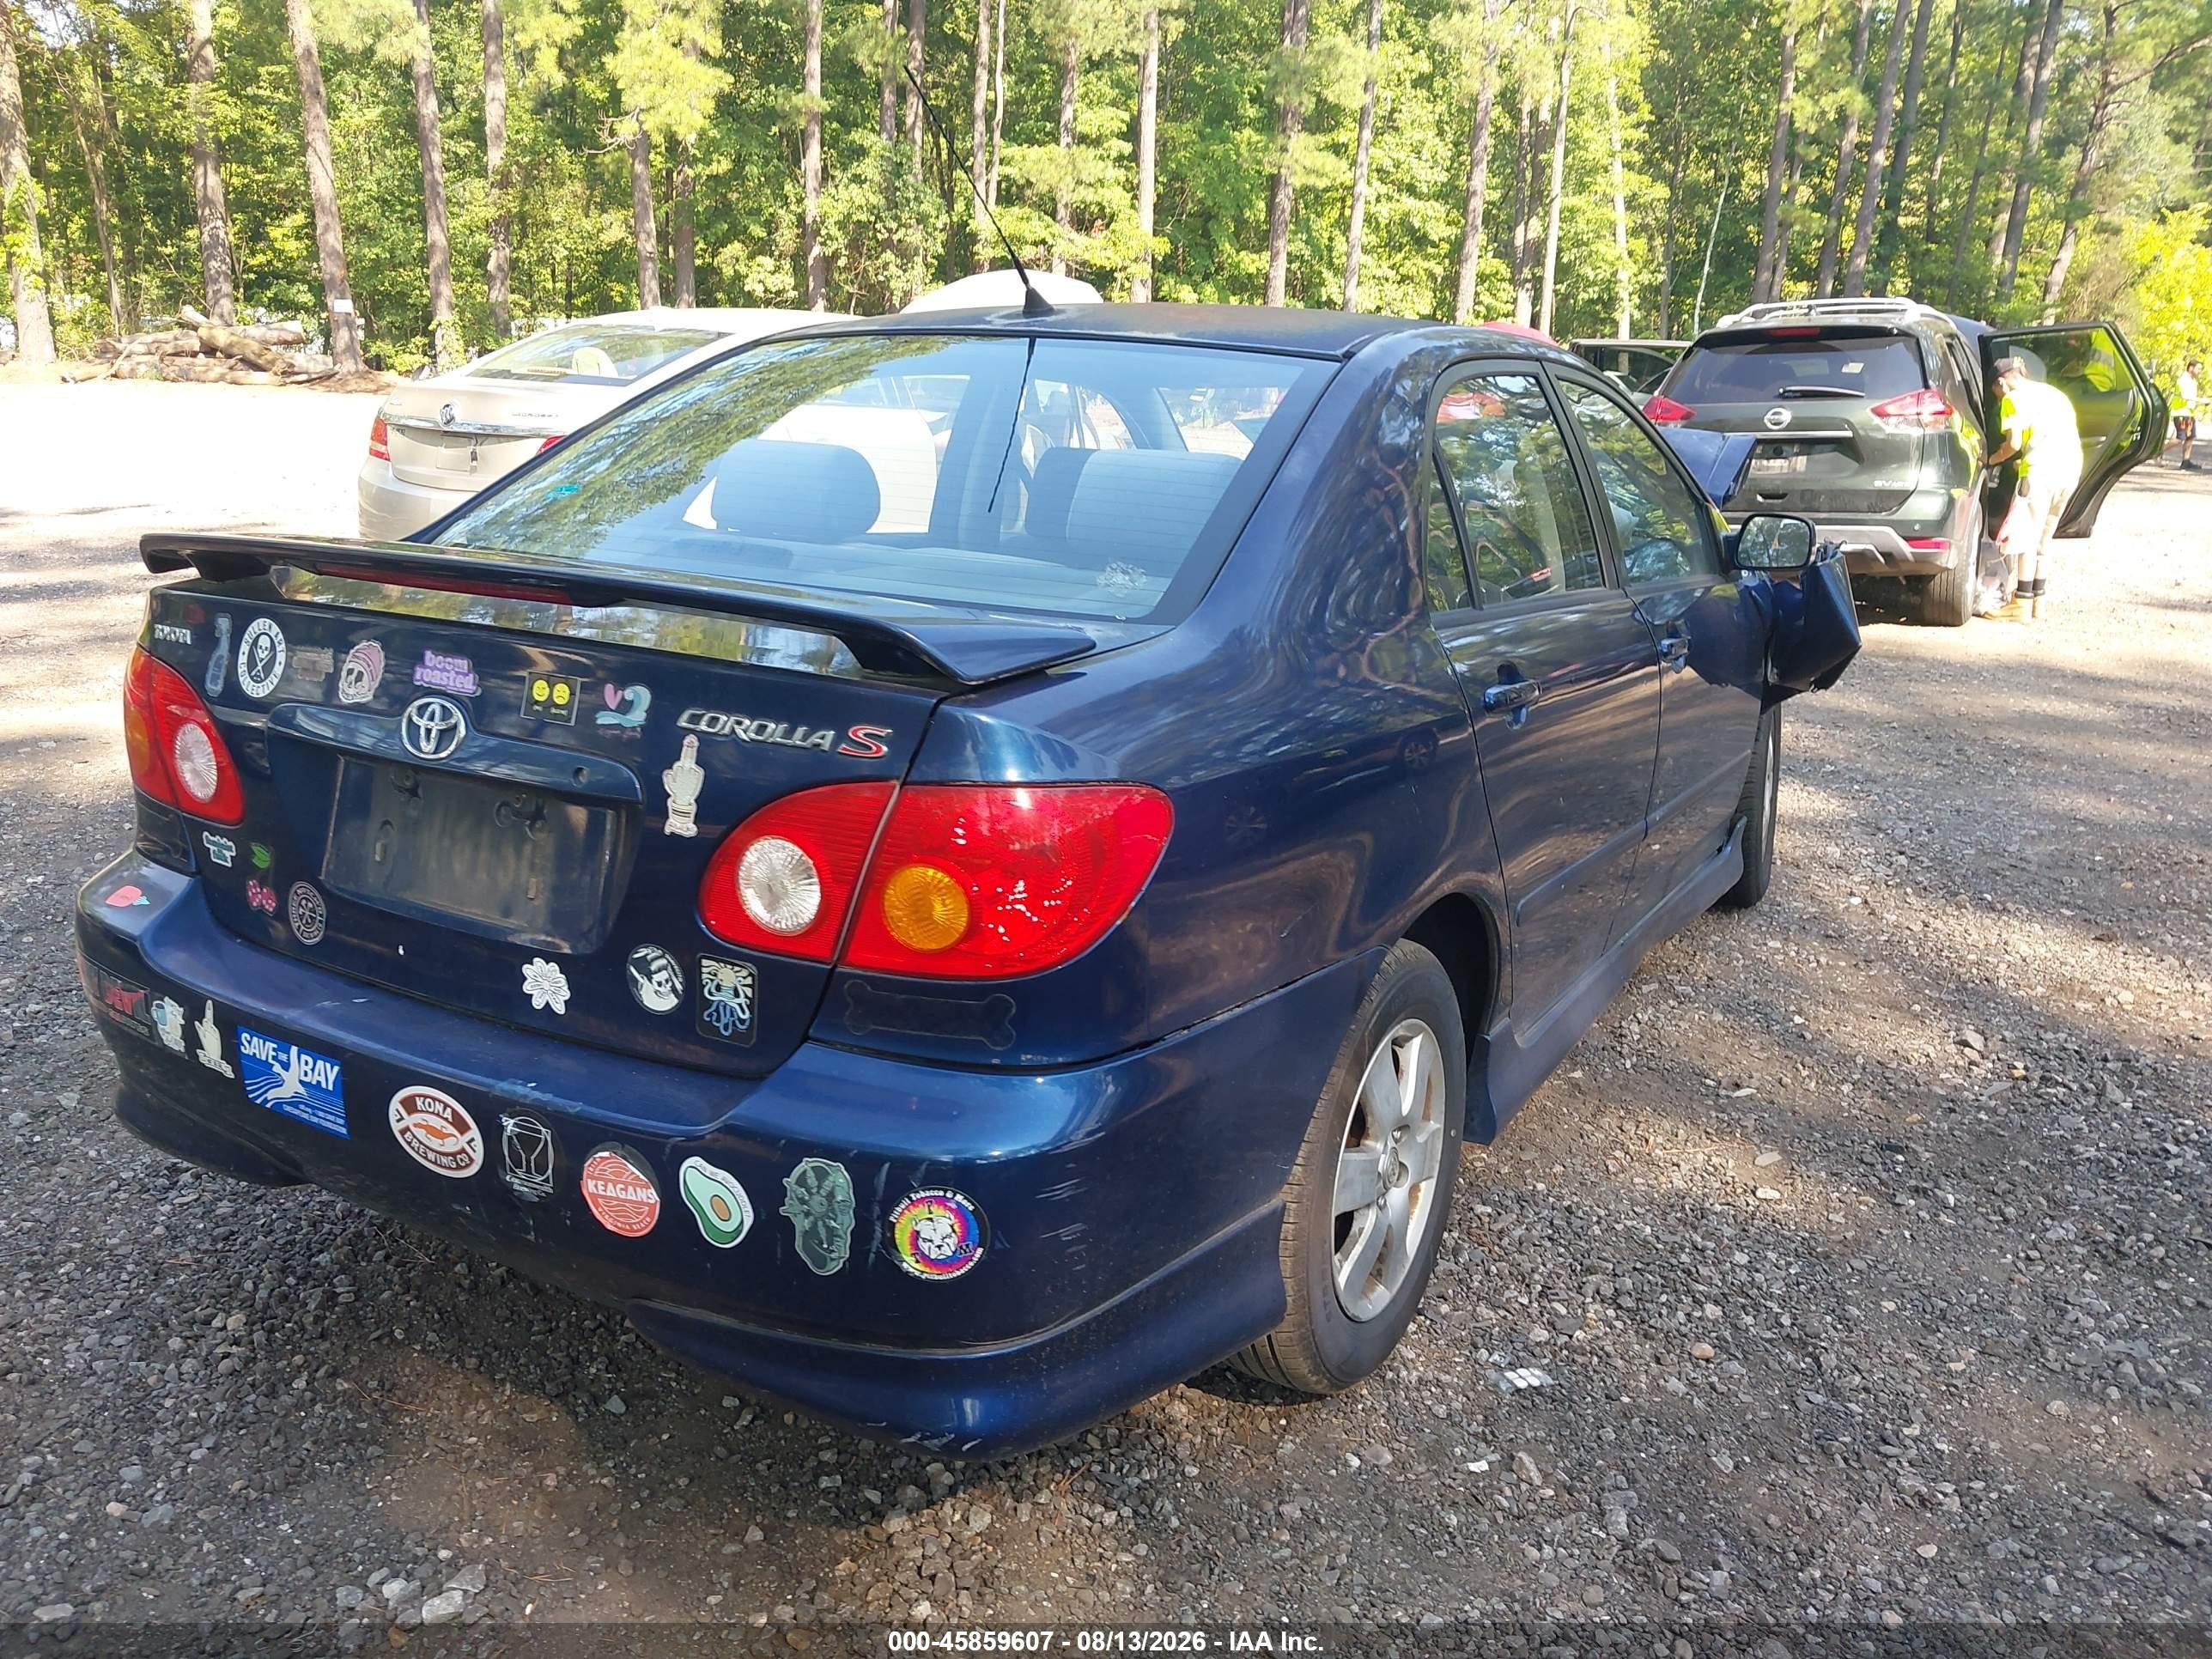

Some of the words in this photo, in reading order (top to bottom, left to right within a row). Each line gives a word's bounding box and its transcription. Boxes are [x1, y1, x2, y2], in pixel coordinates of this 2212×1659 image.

[424, 650, 468, 673] boom
[677, 709, 836, 751] COROLLA
[837, 725, 893, 757] S
[240, 1032, 277, 1065] SAVE
[299, 1054, 340, 1091] BAY
[414, 1097, 453, 1122] KONA
[403, 1131, 456, 1169] BREWING
[586, 1178, 657, 1204] KEAGANS
[889, 1197, 912, 1224] Pitbull
[909, 1189, 945, 1201] Tobacco
[945, 1190, 954, 1199] &
[953, 1193, 975, 1212] More
